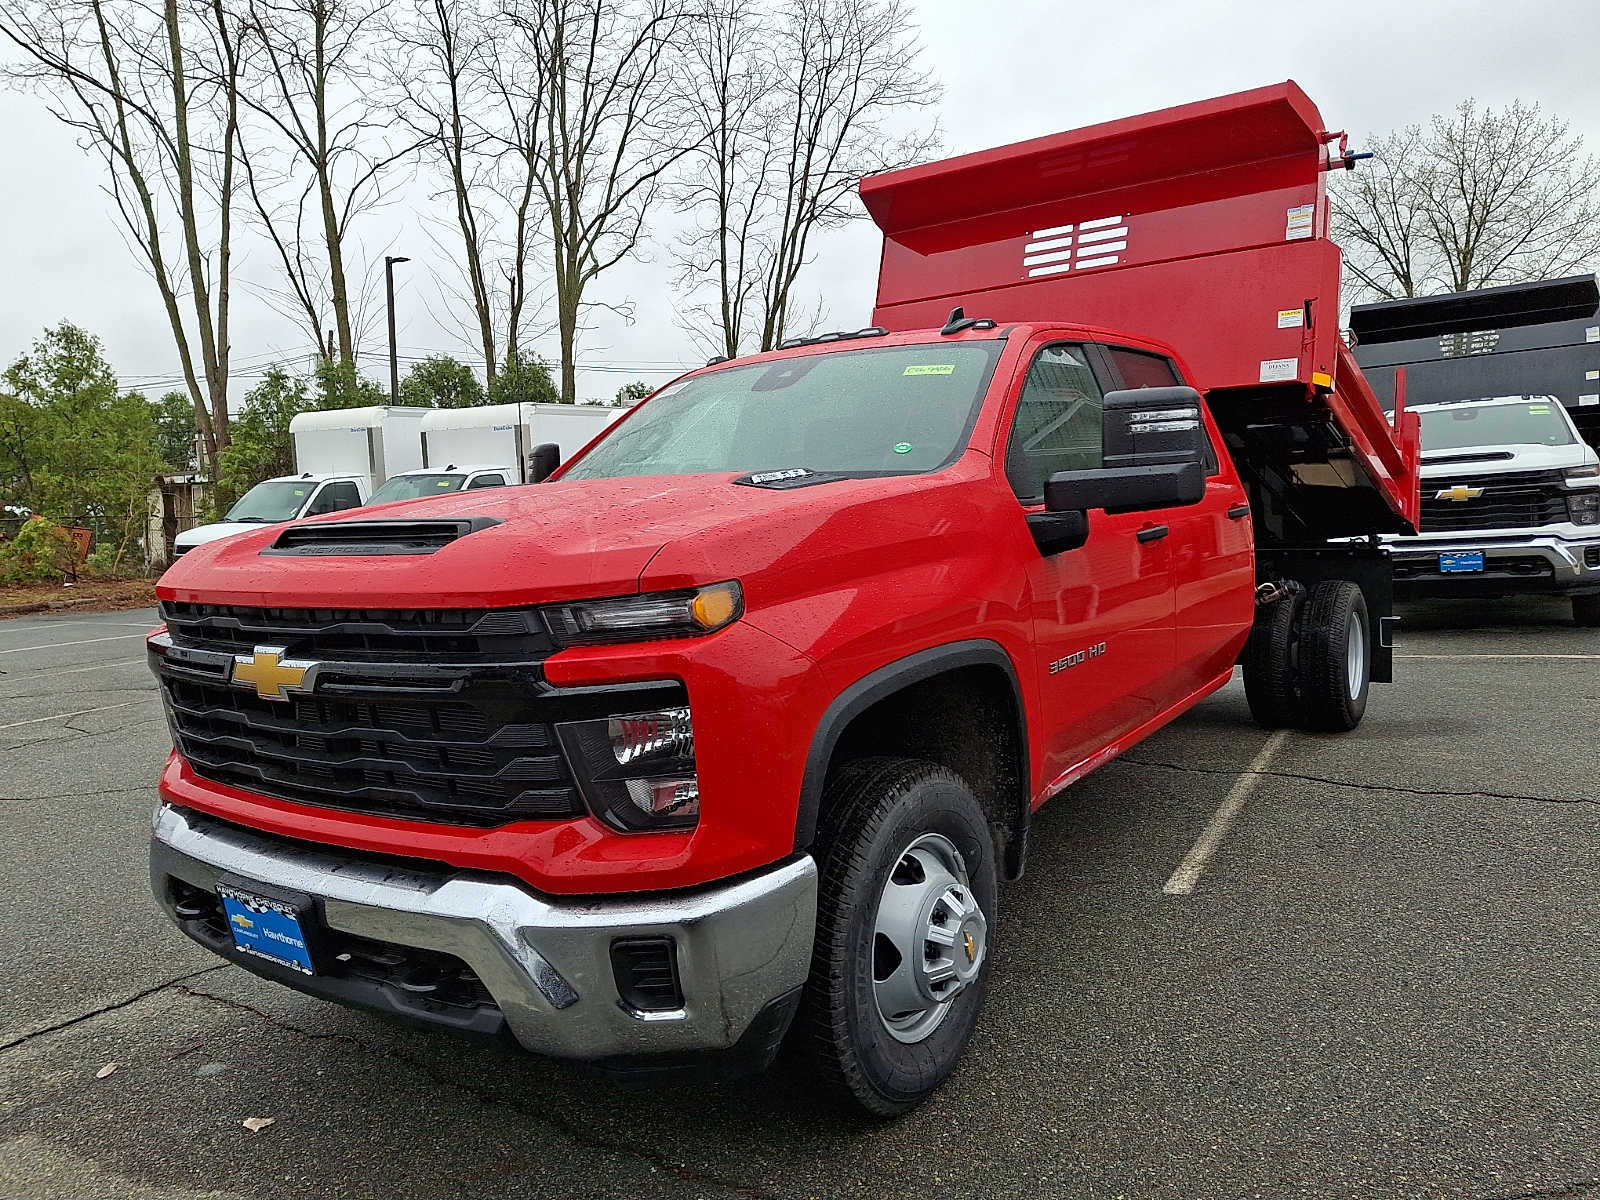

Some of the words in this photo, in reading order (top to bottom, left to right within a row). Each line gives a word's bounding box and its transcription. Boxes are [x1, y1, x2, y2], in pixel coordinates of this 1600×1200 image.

[299, 545, 385, 554] CHEVROLET
[1049, 650, 1085, 675] 3500
[1088, 641, 1106, 659] HD
[216, 885, 254, 903] HAWTHORNE
[255, 897, 293, 914] CHEVROLET
[262, 928, 304, 949] Hawthorne
